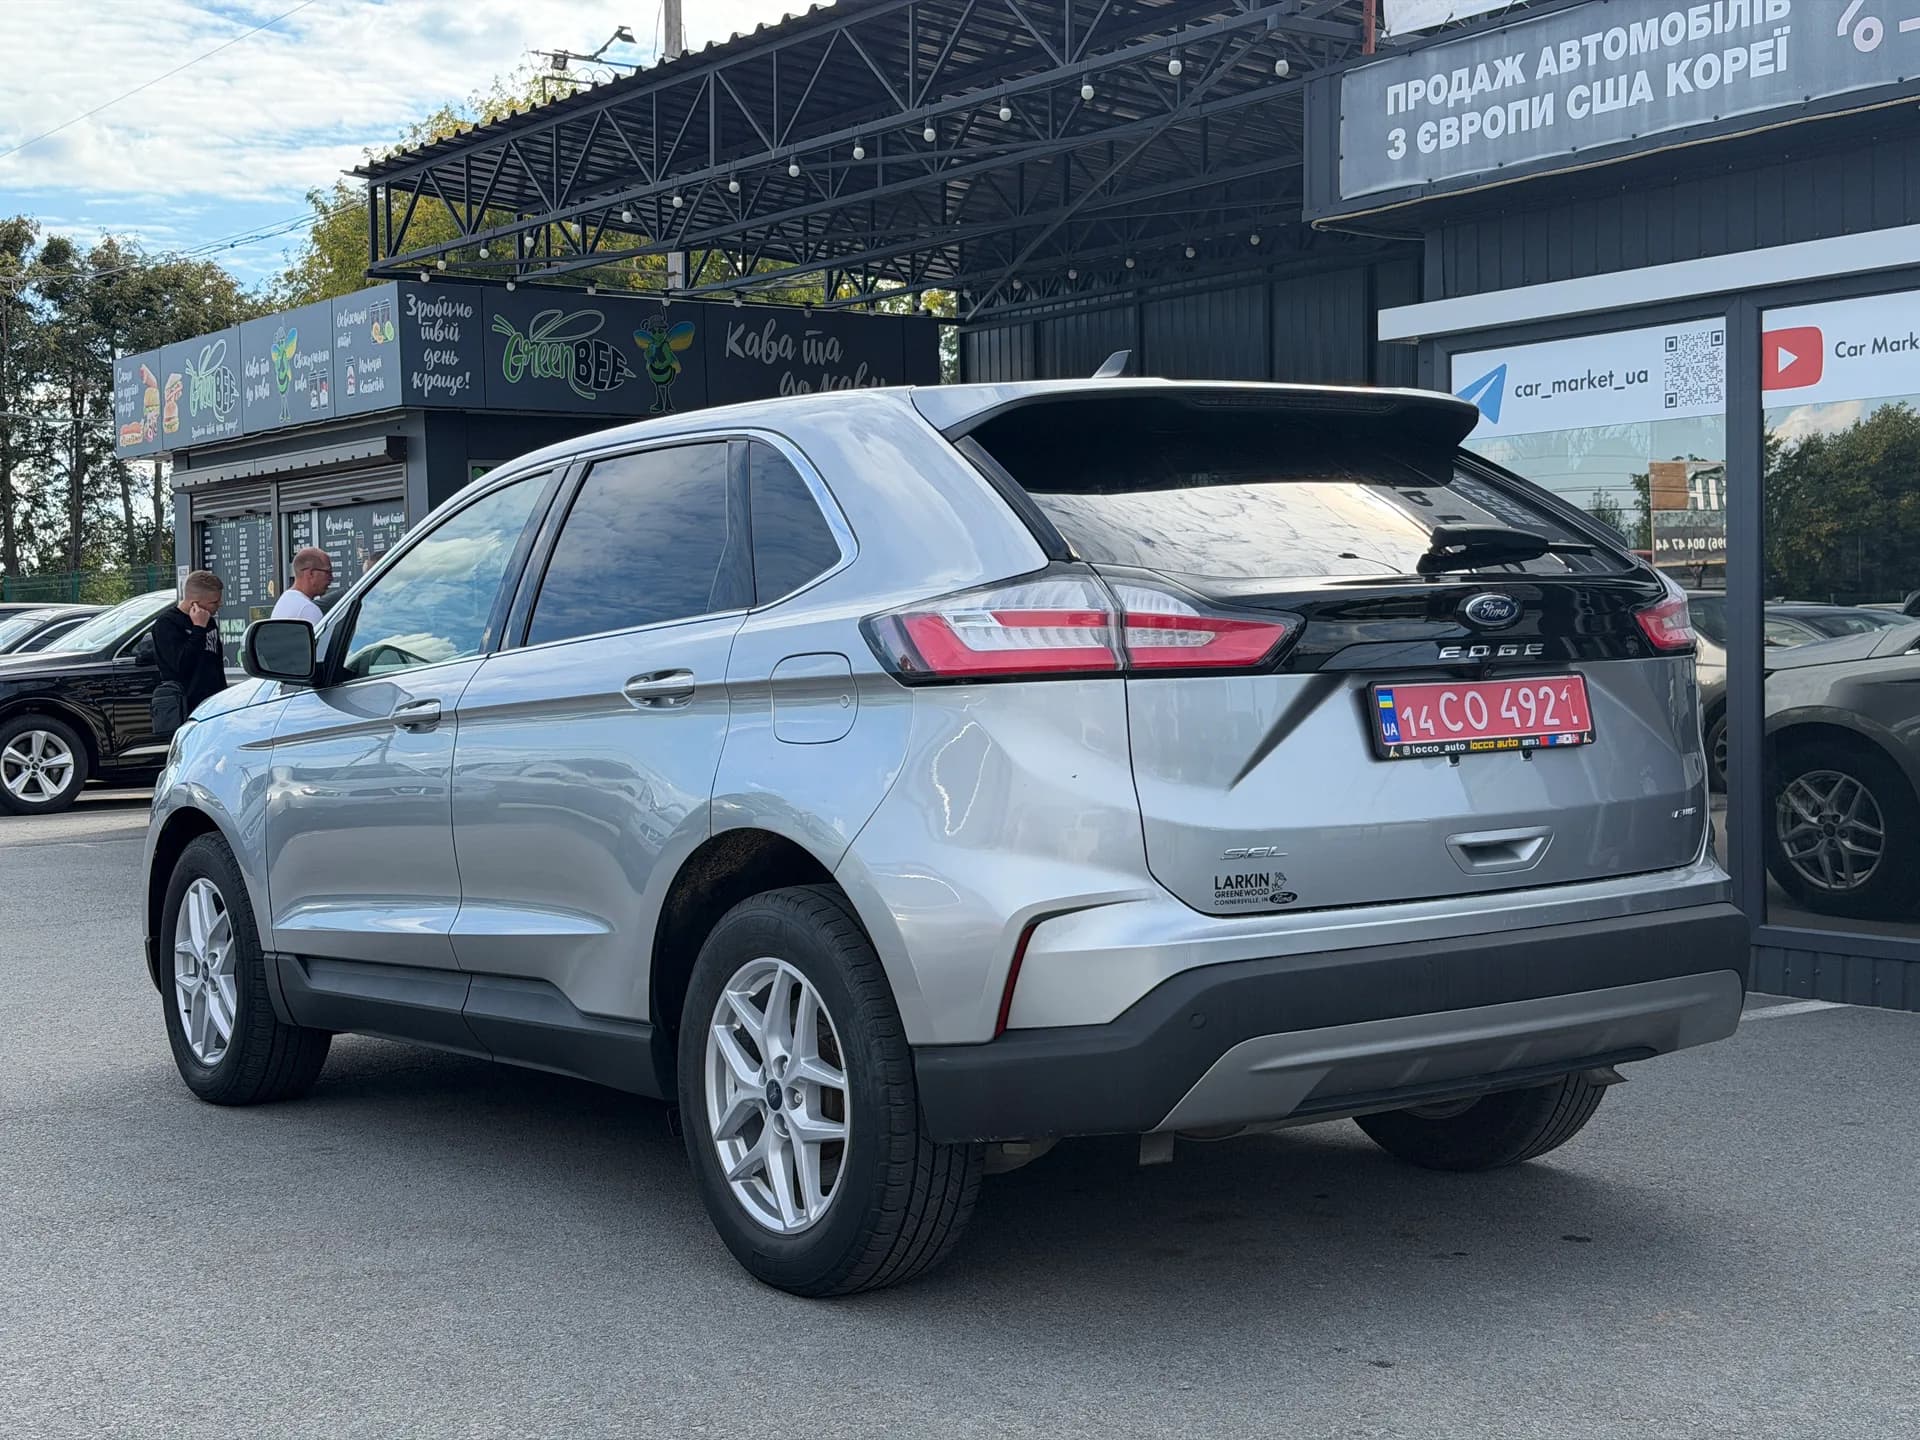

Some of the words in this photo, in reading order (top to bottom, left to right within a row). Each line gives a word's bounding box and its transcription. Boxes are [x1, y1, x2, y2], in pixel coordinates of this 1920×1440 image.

[1387, 52, 1527, 116] ПРОДАЖ
[1535, 0, 1791, 80] АВТОМОБІЛІВ
[1387, 127, 1407, 161] З
[1416, 92, 1554, 154] ЄВРОПИ
[1566, 70, 1655, 120] США
[1666, 25, 1791, 95] КОРЕЇ
[406, 293, 473, 325] Зробимо
[420, 318, 461, 343] твій
[725, 318, 798, 365] Кава
[802, 330, 844, 366] та
[1834, 340, 1867, 358] Car
[1871, 331, 1920, 355] Mark
[423, 348, 460, 370] день
[411, 371, 472, 398] краще!
[1514, 369, 1649, 399] car_market_ua
[1480, 600, 1511, 618] Ford
[1438, 643, 1545, 660] EDGE
[1500, 684, 1579, 729] 4921
[1382, 722, 1399, 737] UA
[1220, 846, 1289, 860] SEL
[1214, 871, 1270, 890] LARKIN
